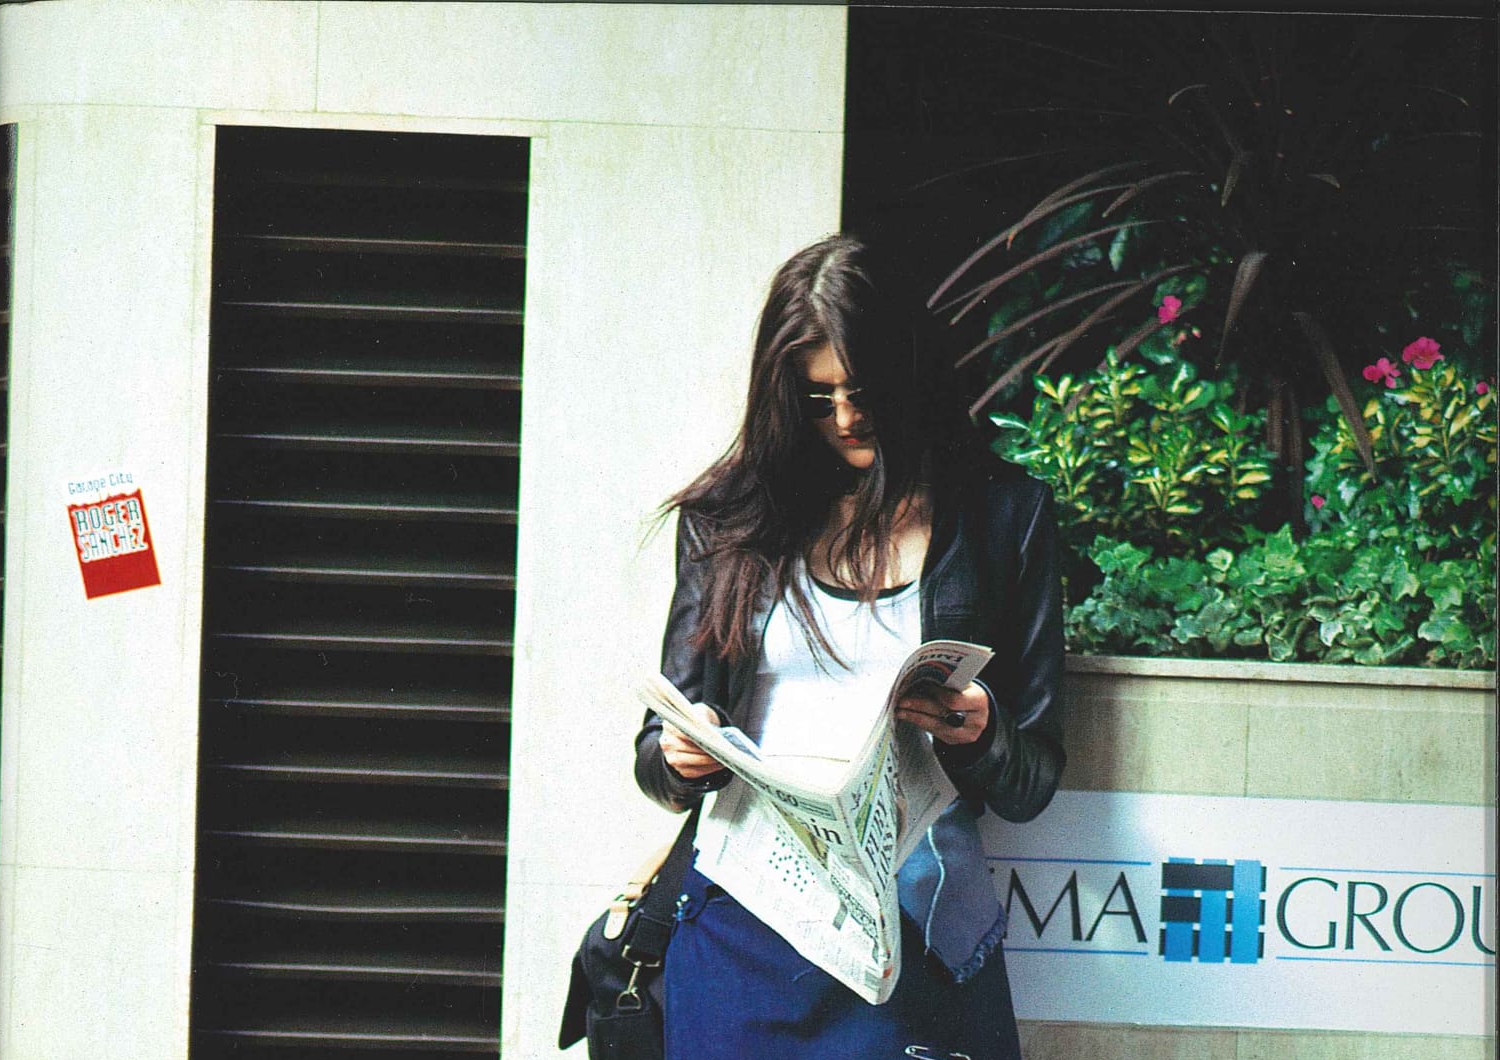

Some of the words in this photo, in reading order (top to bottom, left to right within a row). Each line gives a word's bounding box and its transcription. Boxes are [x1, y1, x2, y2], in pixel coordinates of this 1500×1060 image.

[108, 472, 133, 487] City
[74, 499, 141, 534] ROGER
[79, 522, 146, 560] SANCHEZ
